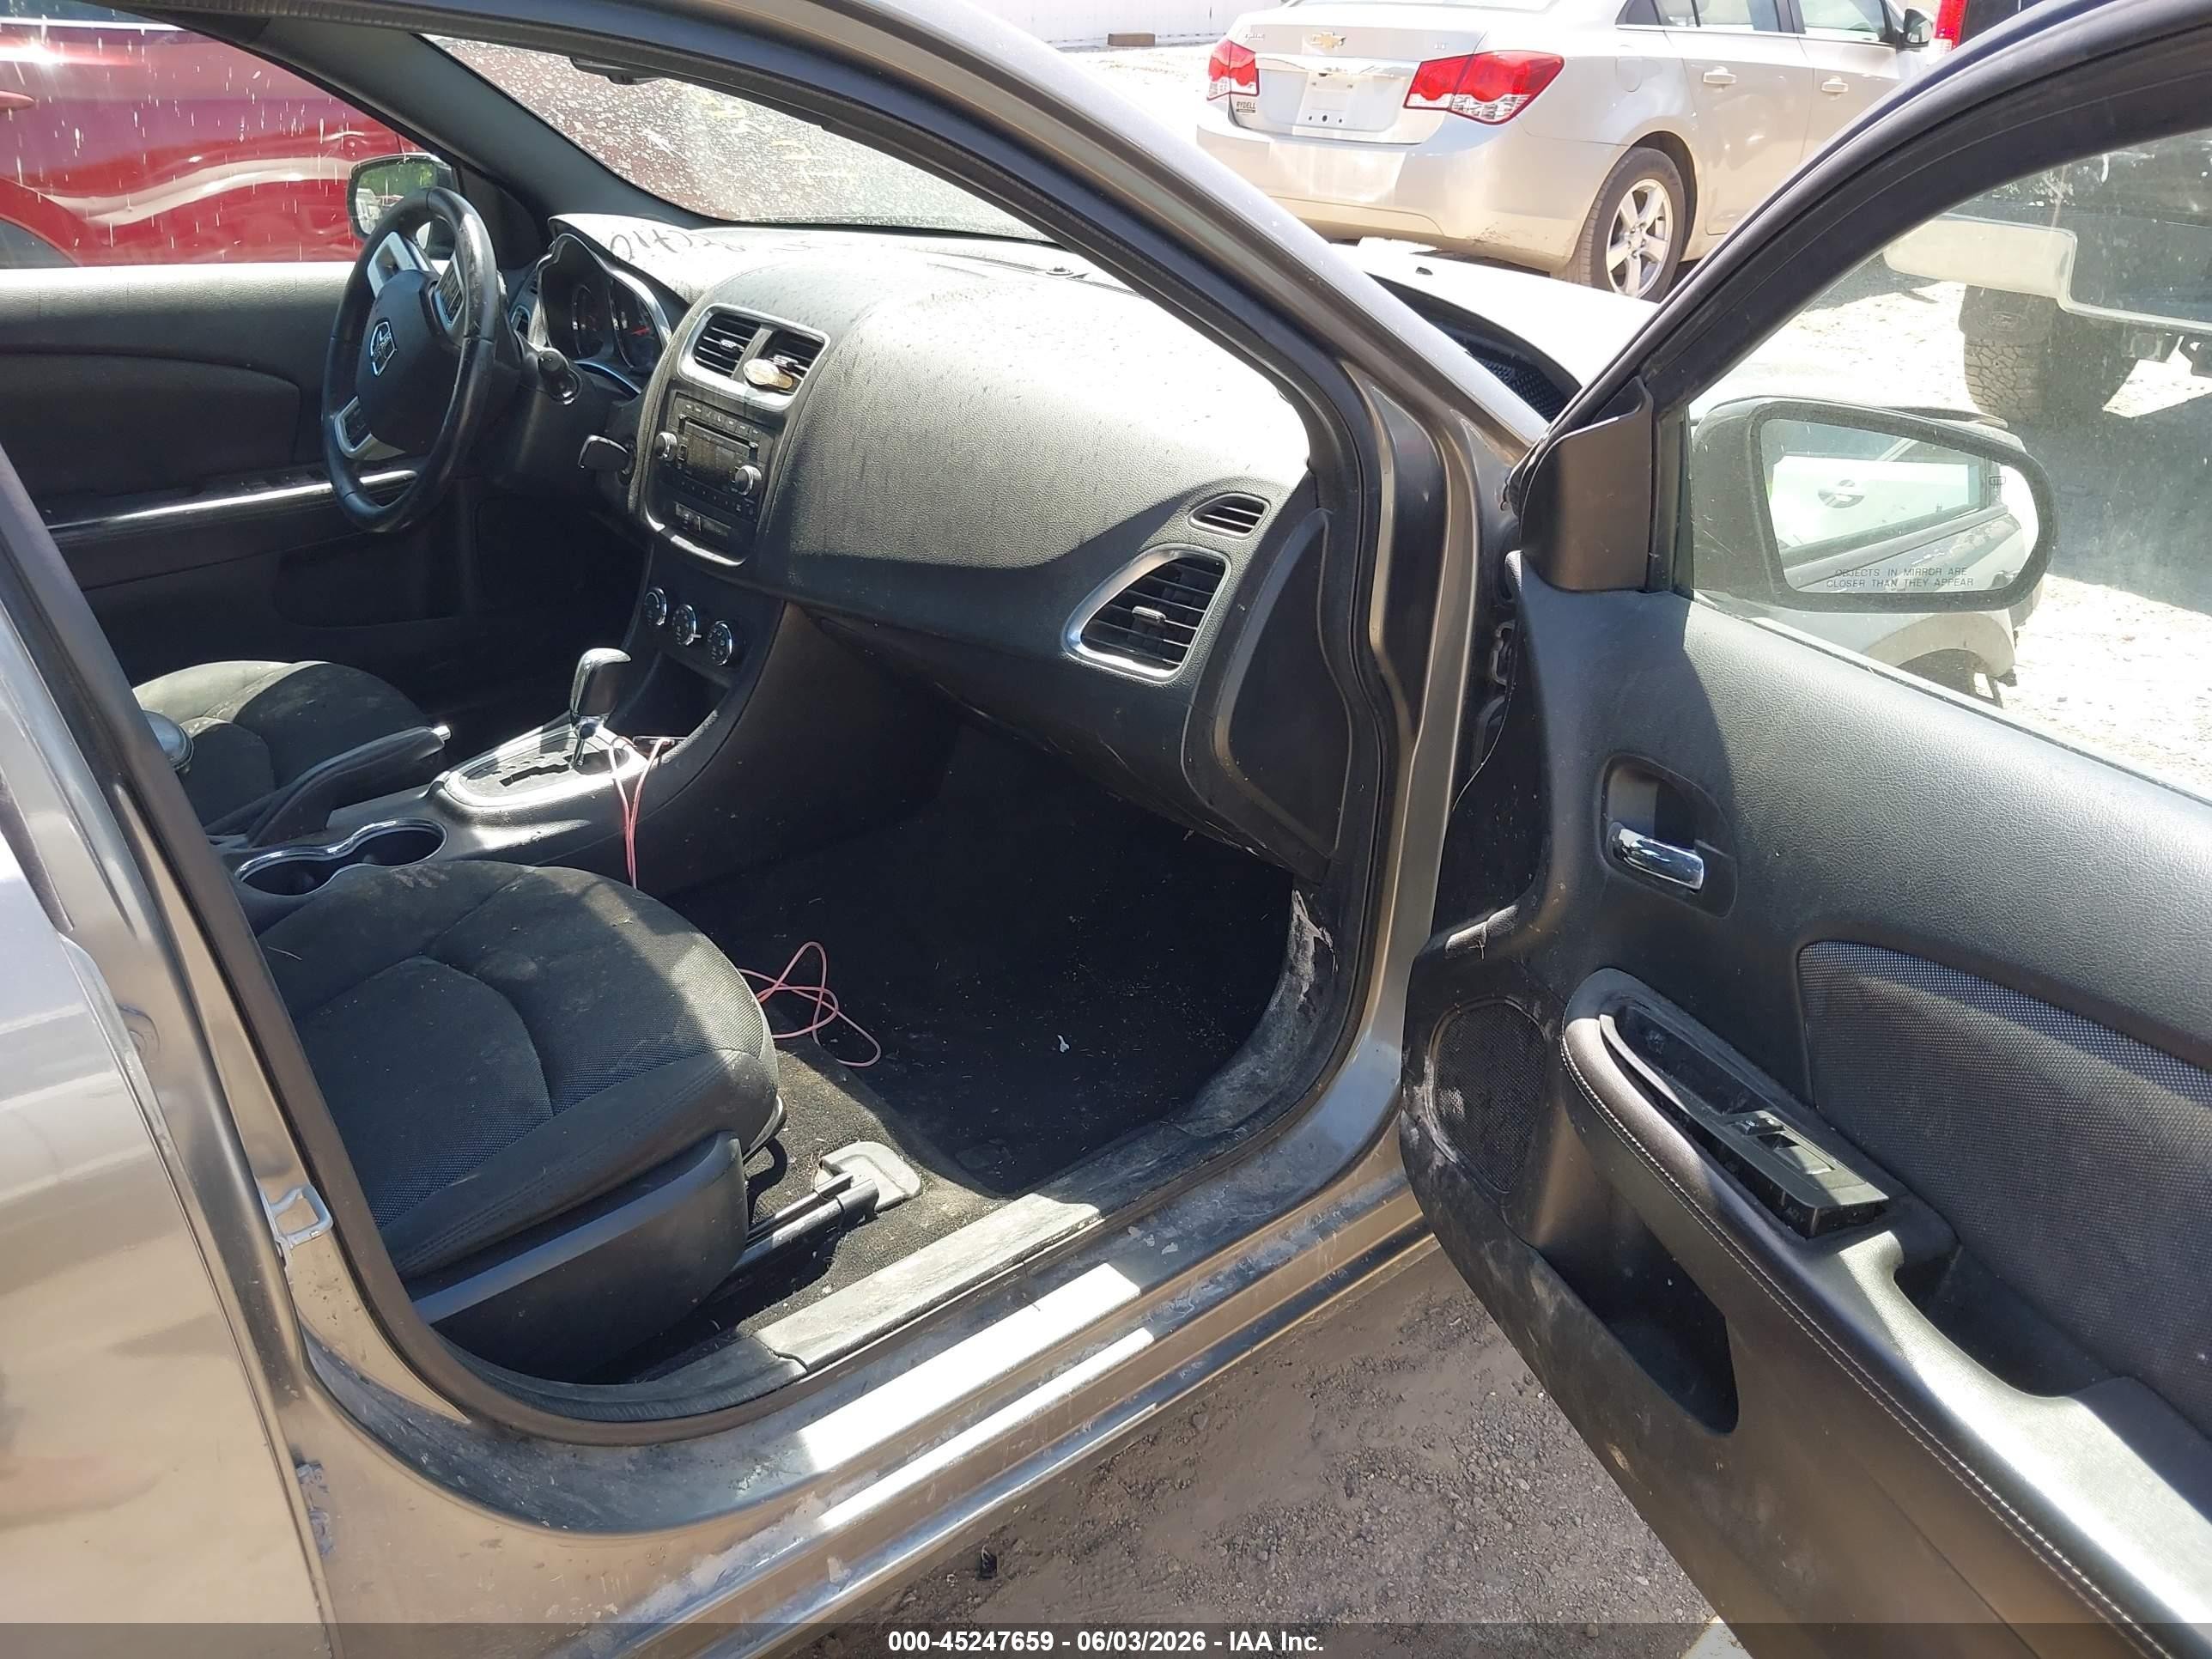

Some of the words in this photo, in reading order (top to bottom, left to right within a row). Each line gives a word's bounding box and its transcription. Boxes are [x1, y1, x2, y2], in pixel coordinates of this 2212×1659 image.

[1835, 568, 1880, 577] OBJECTS
[1904, 568, 1942, 576] MIRROR
[1826, 580, 1865, 588] CLOSER
[1872, 579, 1898, 587] THAN
[1905, 578, 1929, 587] THEY
[1935, 578, 1973, 586] APPEAR
